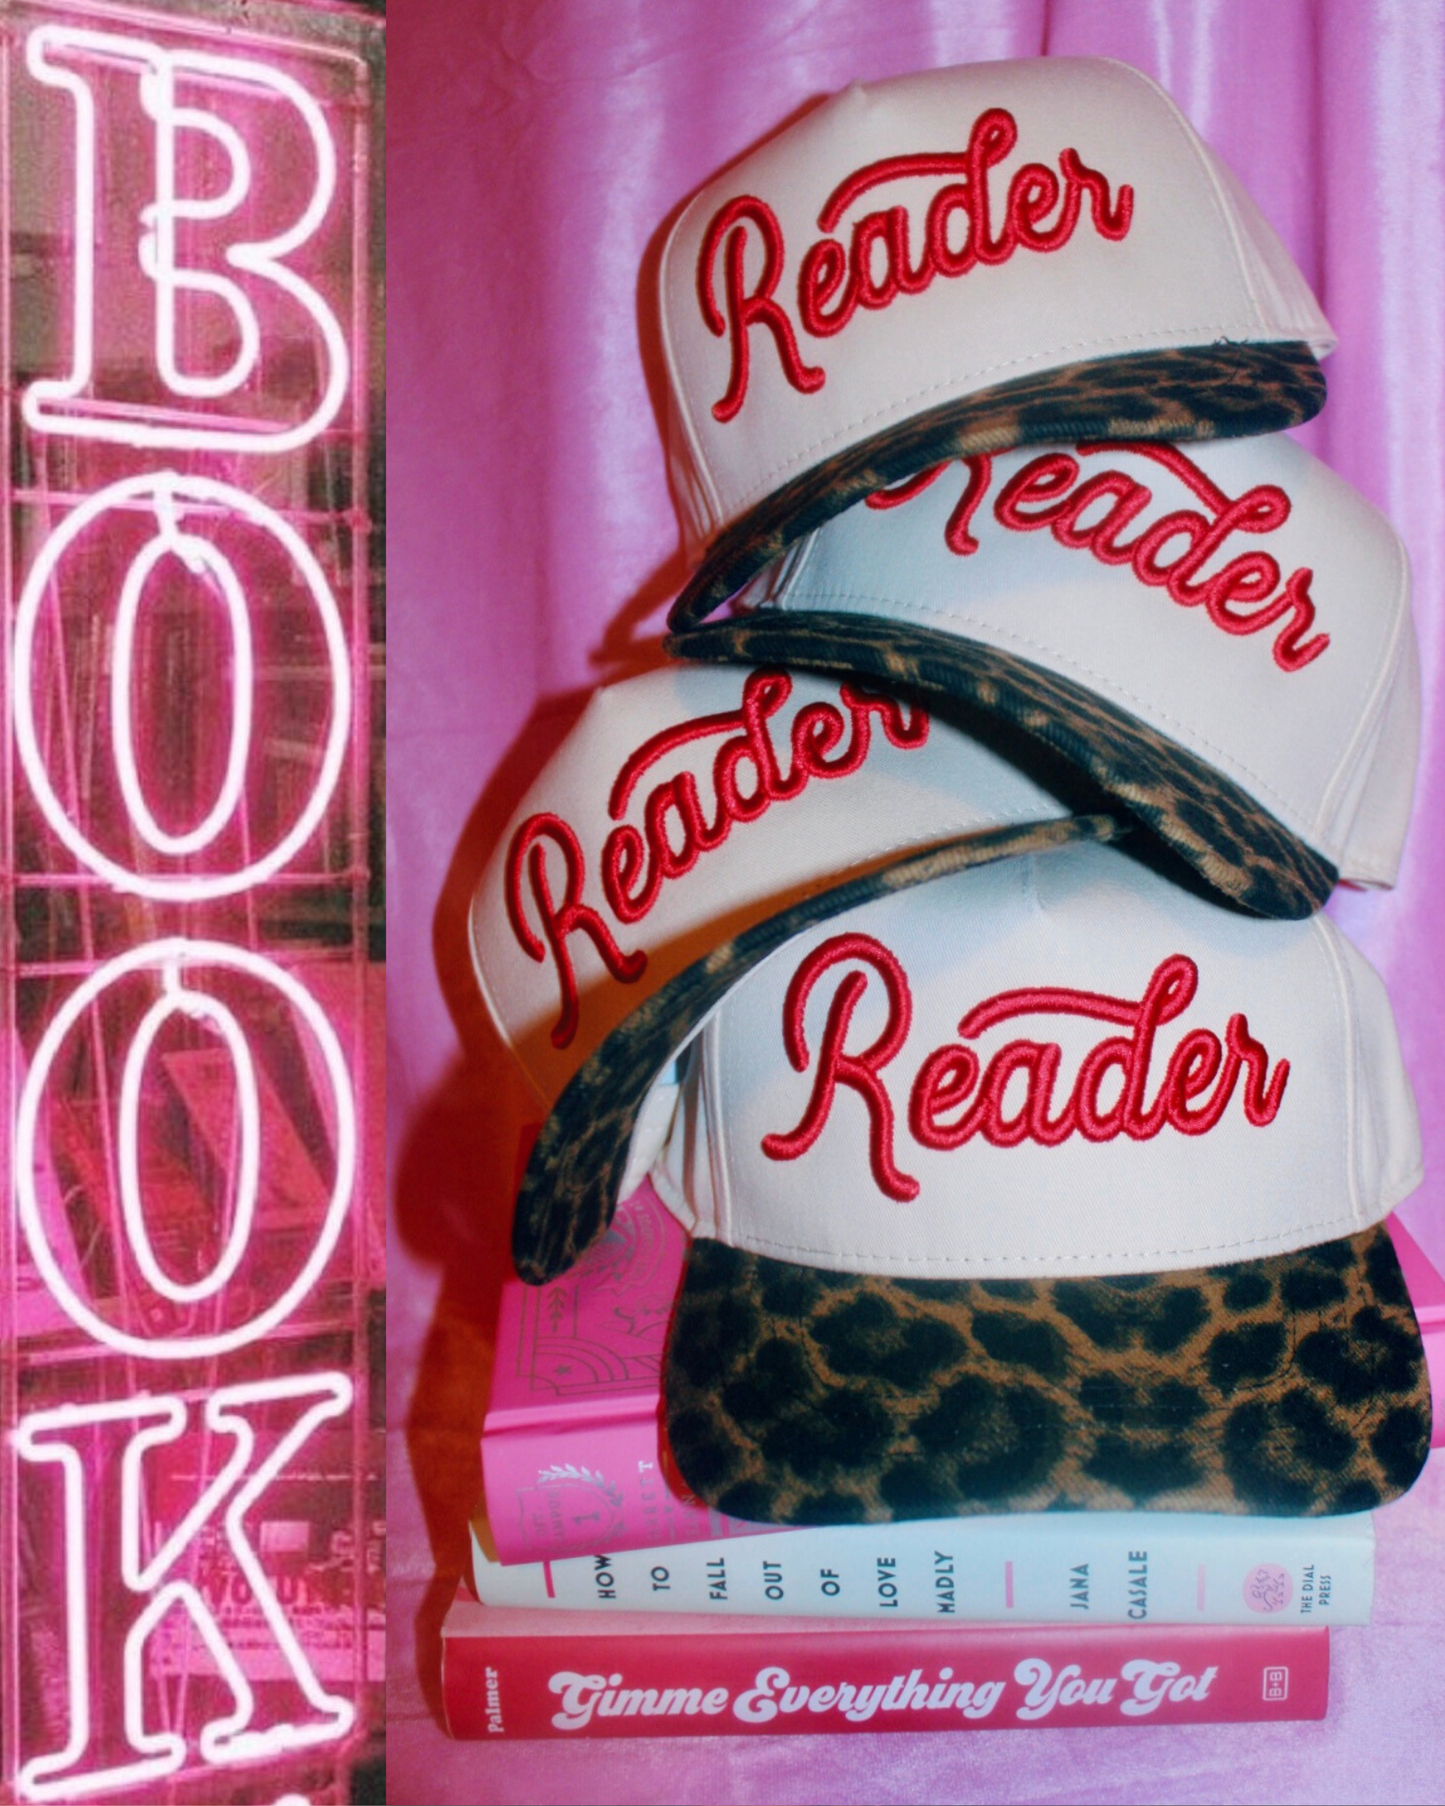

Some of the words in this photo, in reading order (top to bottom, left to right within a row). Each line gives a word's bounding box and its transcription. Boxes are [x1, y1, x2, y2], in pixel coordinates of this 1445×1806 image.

[695, 108, 1135, 423] Reader
[502, 665, 929, 1049] Reader
[761, 932, 1291, 1202] Reader
[594, 1555, 616, 1599] HOW
[650, 1566, 670, 1591] TO
[706, 1557, 728, 1600] FALL
[763, 1561, 784, 1600] OUT
[820, 1568, 841, 1596] OF
[877, 1557, 898, 1608] LOVE
[933, 1550, 956, 1614] MADLY
[1070, 1562, 1090, 1610] JANA
[1127, 1550, 1148, 1620] CASALE
[1301, 1588, 1313, 1614] THE
[1302, 1563, 1315, 1587] DIAL
[1318, 1574, 1331, 1606] PRESS
[485, 1667, 504, 1734] Palmer
[548, 1671, 729, 1730] Gimme
[732, 1667, 1006, 1723] Everything
[1013, 1658, 1118, 1720] You
[1119, 1658, 1219, 1717] Got
